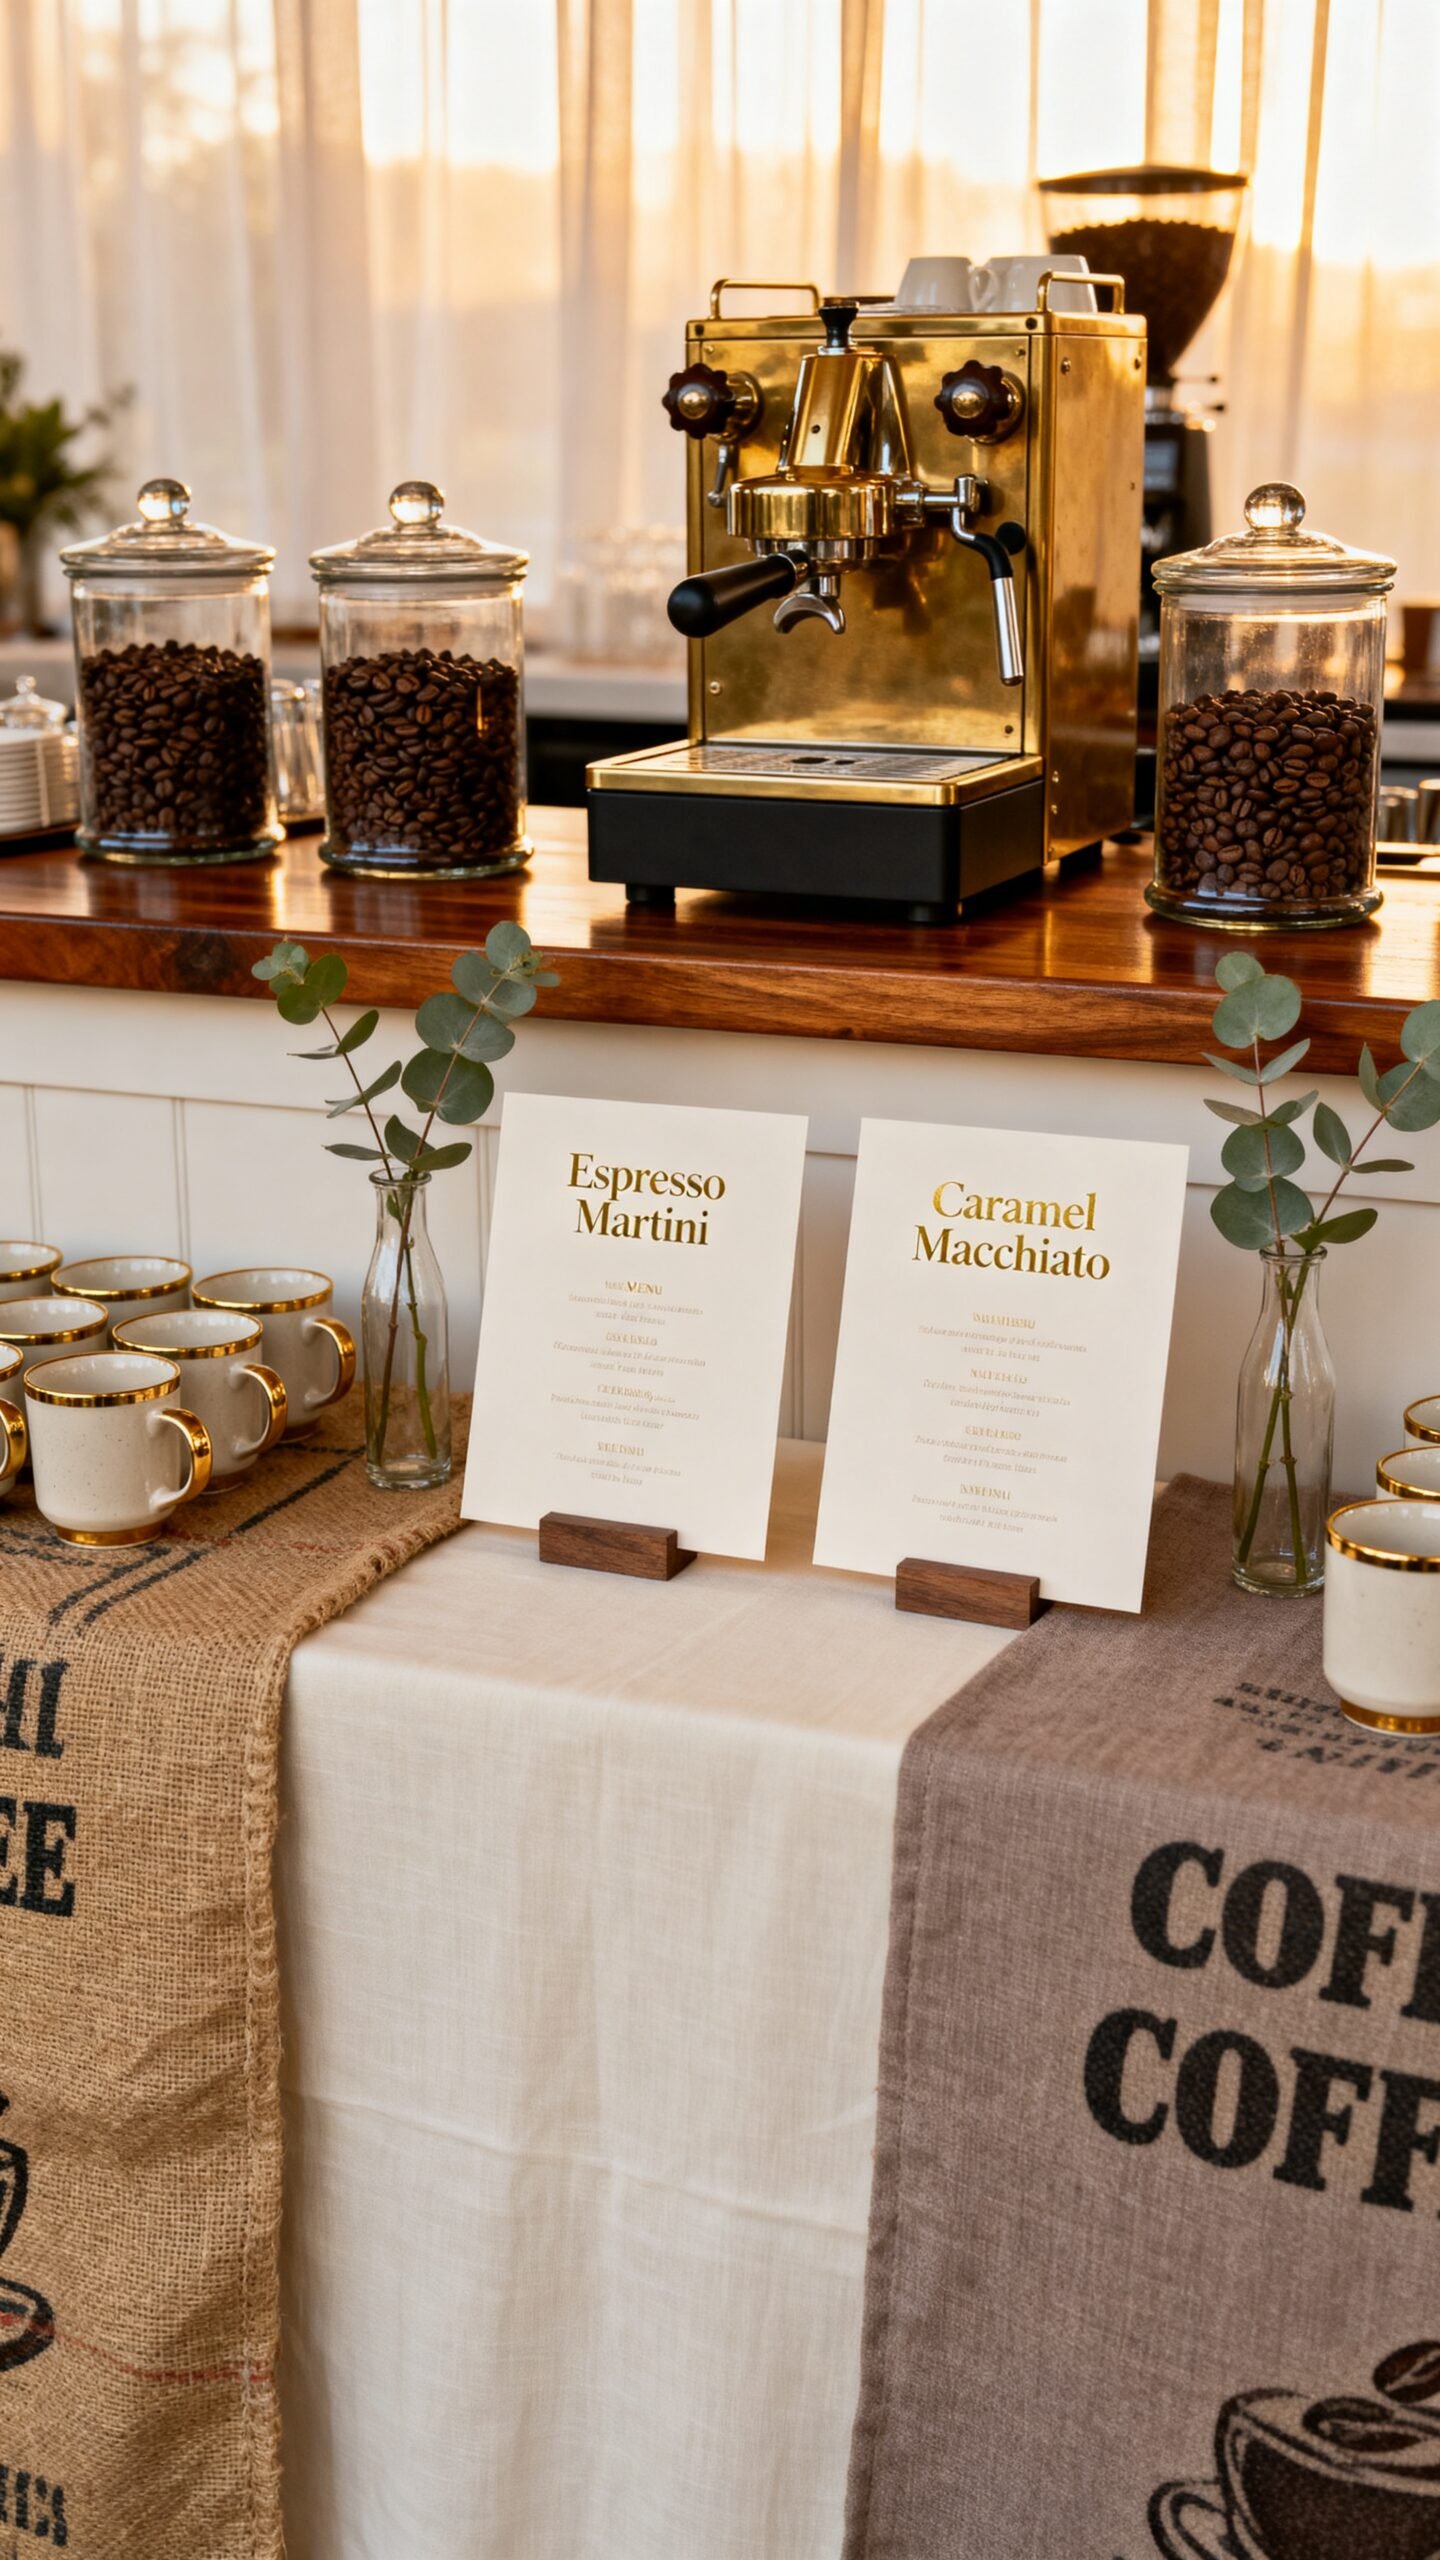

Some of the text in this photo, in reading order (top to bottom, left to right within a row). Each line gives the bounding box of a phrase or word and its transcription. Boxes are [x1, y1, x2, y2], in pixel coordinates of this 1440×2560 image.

[567, 1152, 726, 1202] Espresso
[574, 1198, 709, 1246] Martini
[932, 1181, 1097, 1232] Caramel
[911, 1225, 1111, 1281] Macchiato
[1083, 2007, 1440, 2220] COFF
